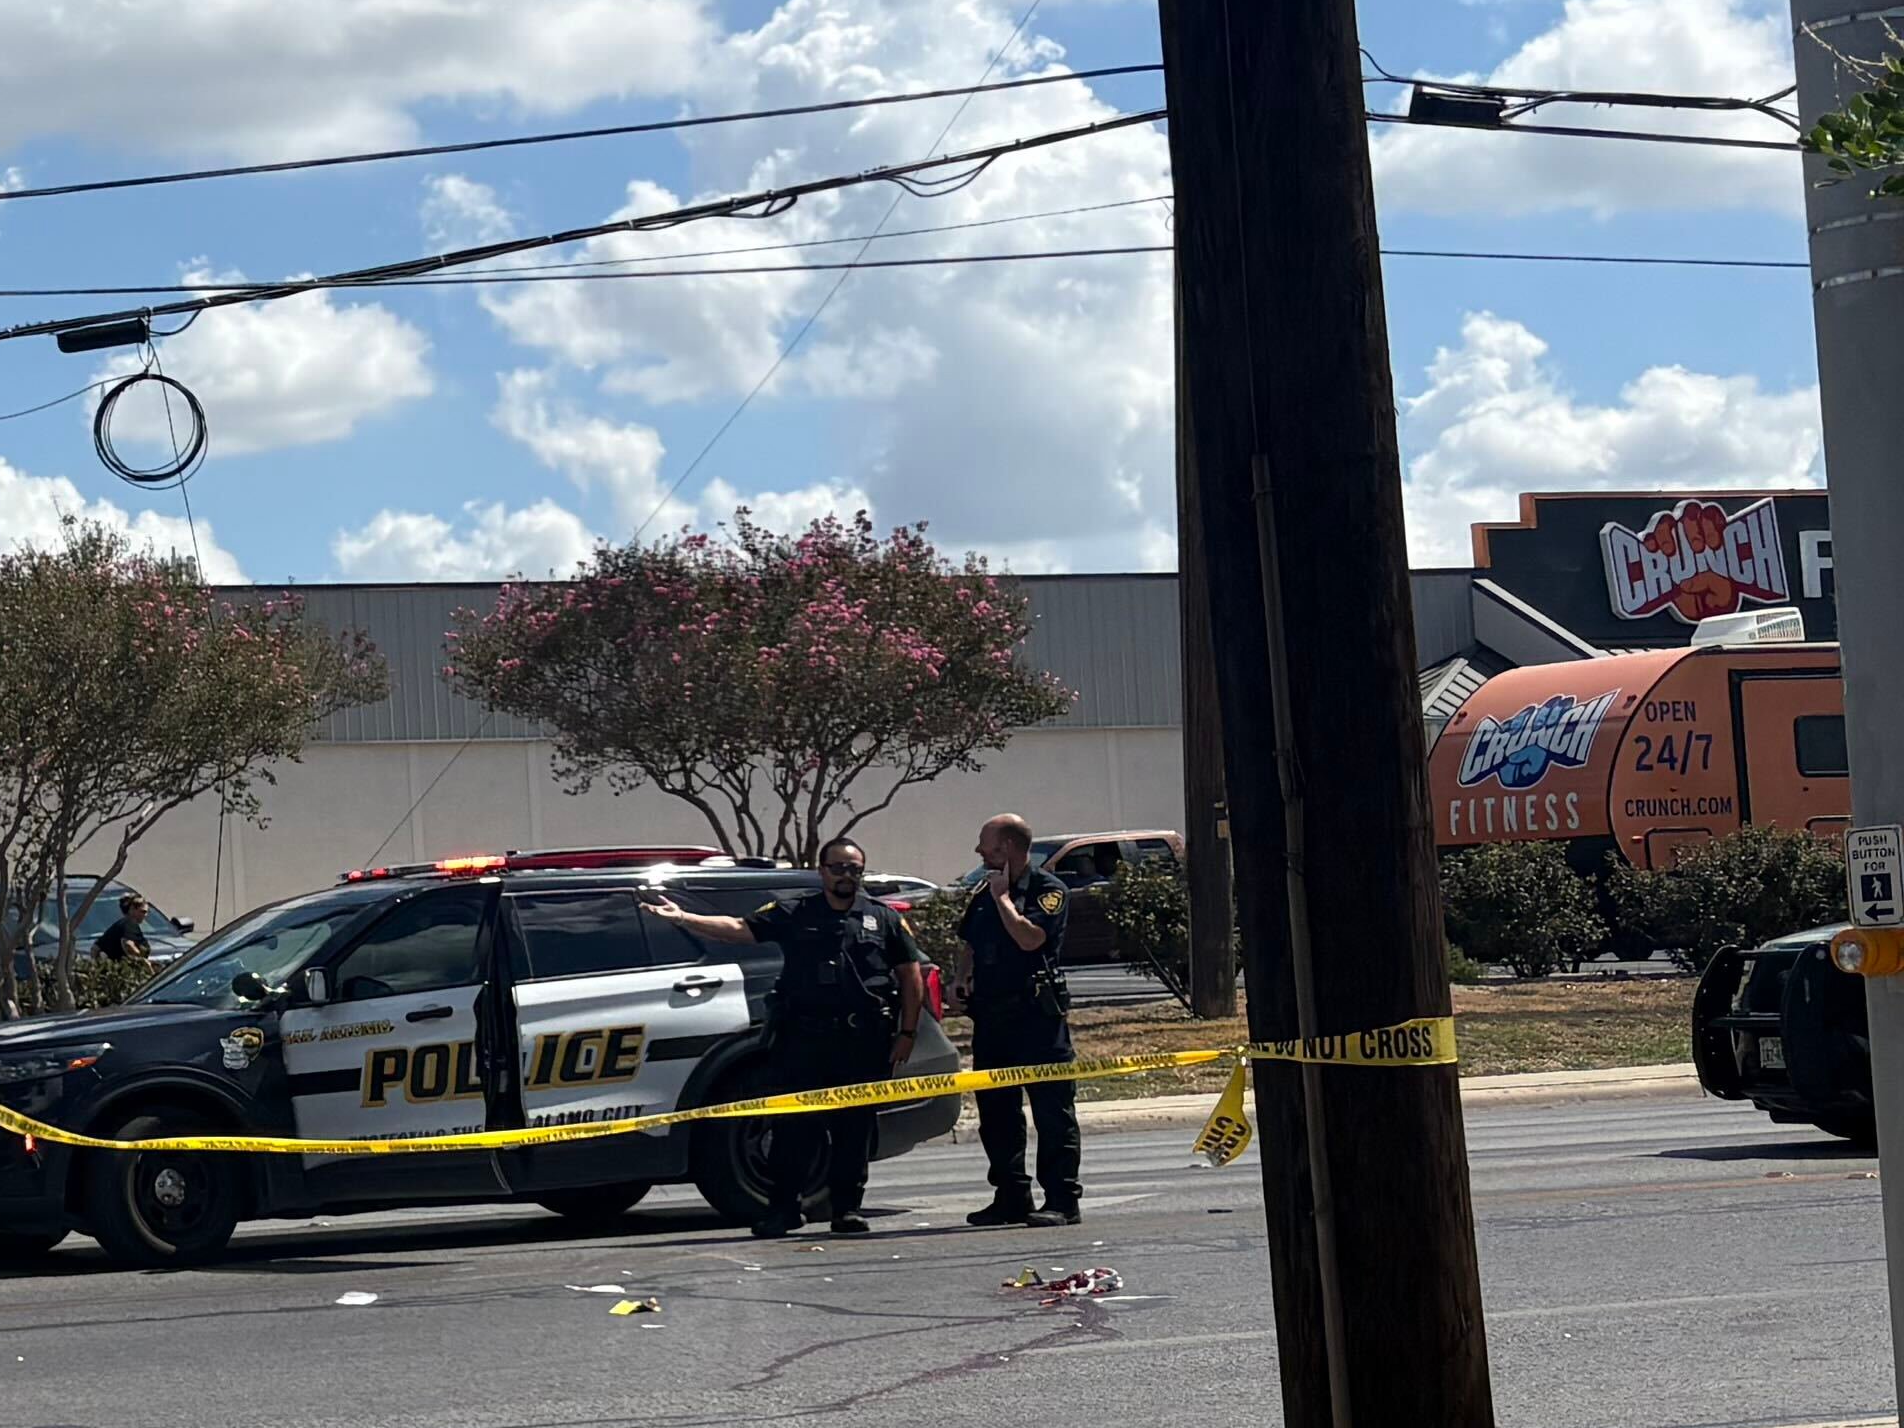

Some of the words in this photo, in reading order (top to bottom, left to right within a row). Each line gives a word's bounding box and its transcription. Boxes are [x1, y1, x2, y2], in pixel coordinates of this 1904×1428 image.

[1614, 505, 1786, 615] CRUNCH
[1645, 701, 1697, 723] OPEN
[1459, 690, 1618, 784] CRUNCH
[1634, 729, 1713, 776] 24/7
[1449, 791, 1581, 837] FITNESS
[1624, 796, 1733, 818] CRUNCH.COM
[1852, 847, 1896, 860] BUTTON
[1858, 834, 1888, 847] PUSH
[1864, 861, 1886, 873] FOR
[1359, 1026, 1433, 1060] CROSS
[360, 1025, 646, 1108] POLICE
[602, 1104, 646, 1120] CITY
